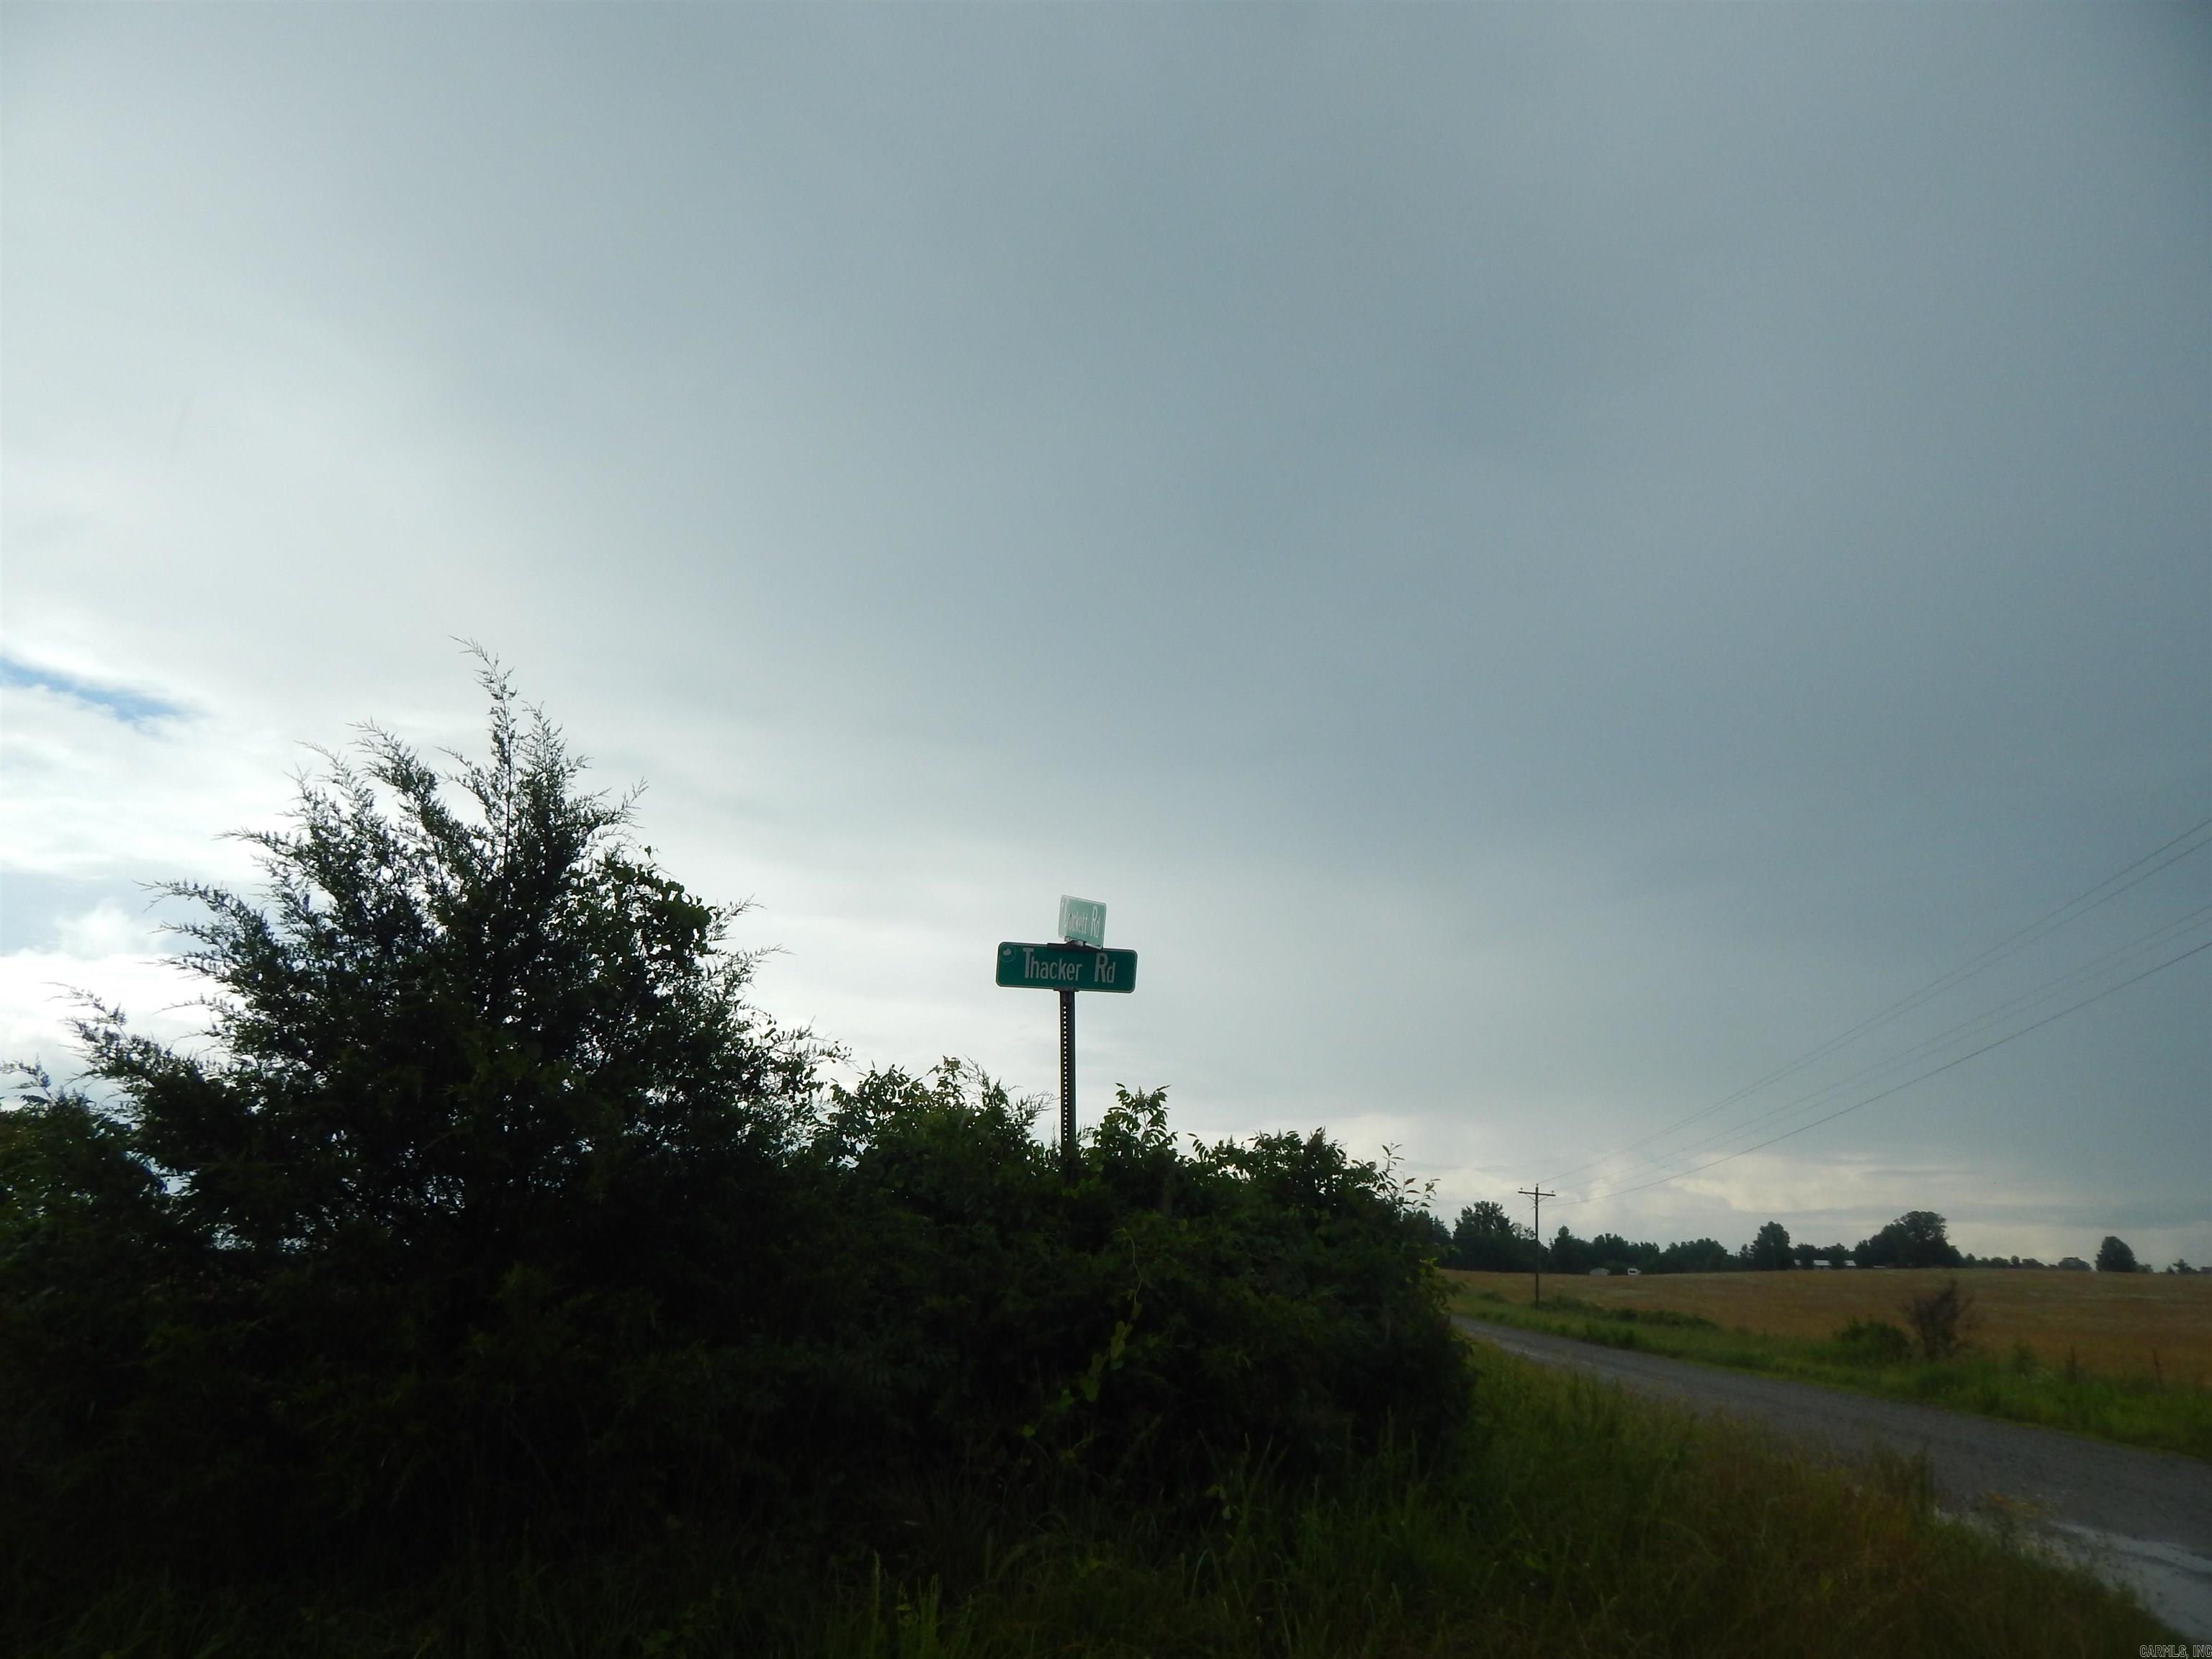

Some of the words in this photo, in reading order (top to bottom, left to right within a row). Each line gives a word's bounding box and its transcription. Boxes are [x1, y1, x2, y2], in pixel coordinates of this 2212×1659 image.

[1090, 905, 1101, 938] Rd
[1022, 947, 1083, 981] Thacker
[1094, 953, 1116, 984] Rd
